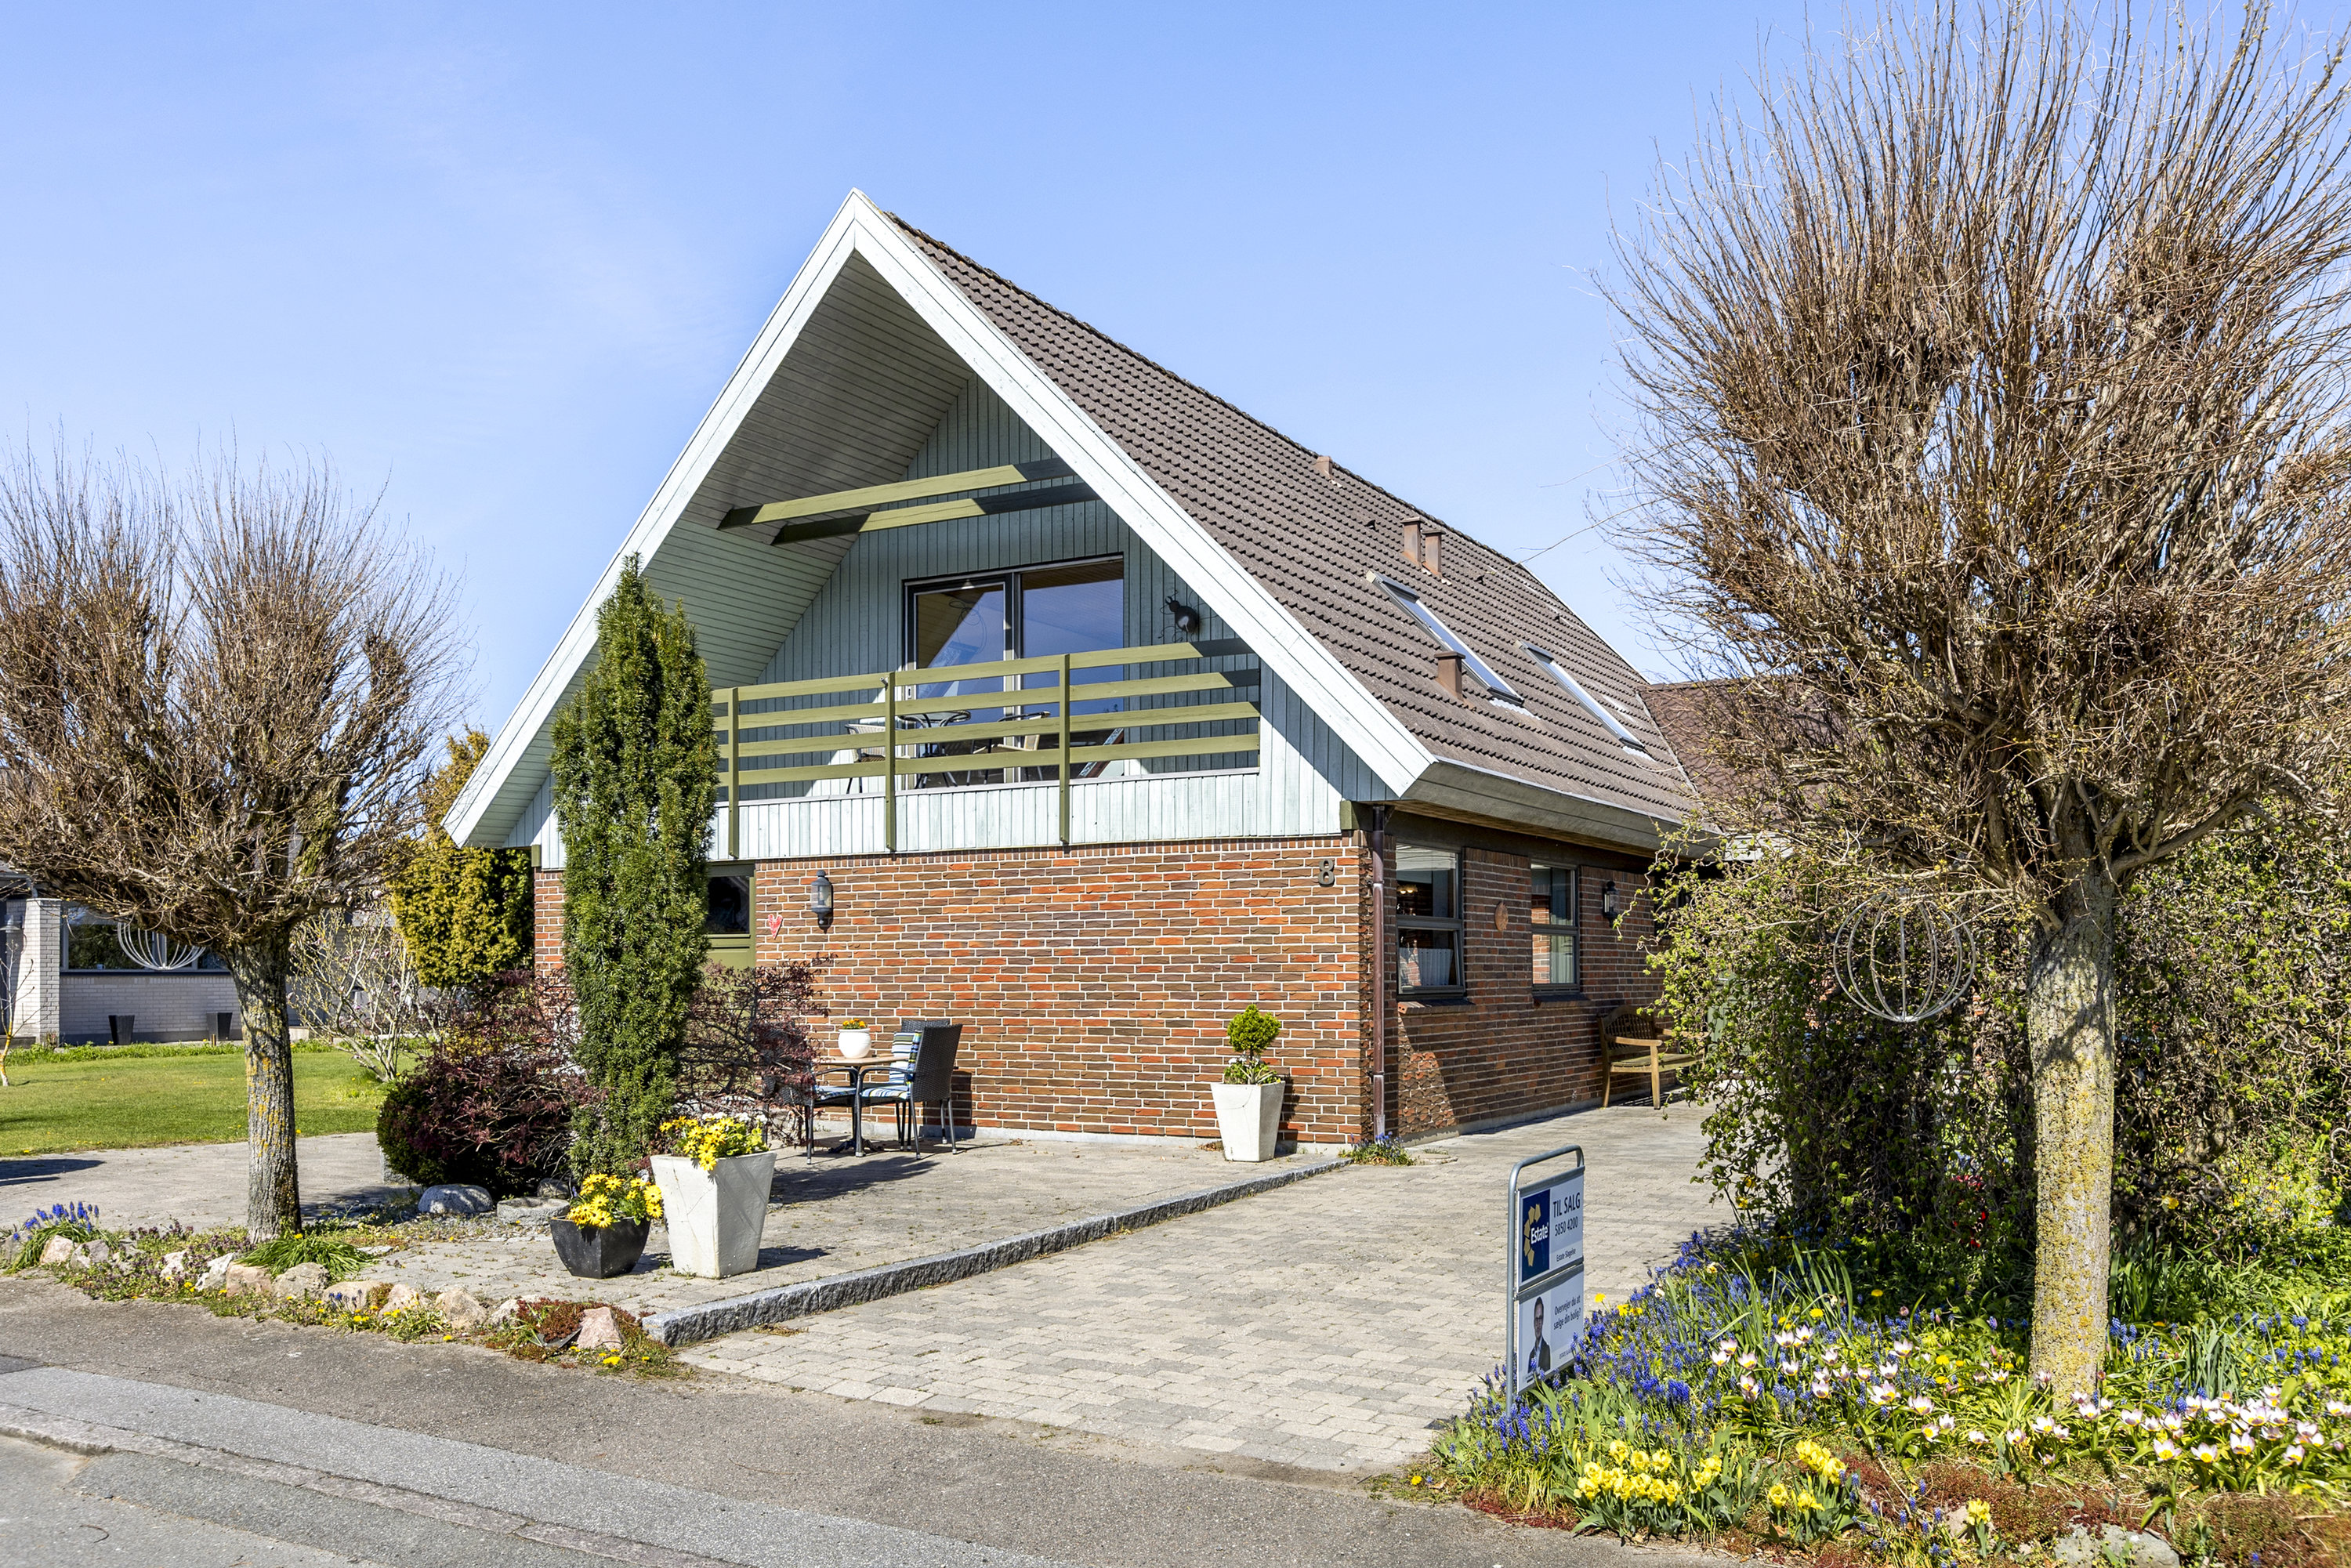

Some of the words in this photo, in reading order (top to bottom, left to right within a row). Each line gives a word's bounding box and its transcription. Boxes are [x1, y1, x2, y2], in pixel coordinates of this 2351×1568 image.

[1318, 858, 1335, 887] 8
[1552, 1199, 1562, 1218] TIL
[1564, 1192, 1580, 1214] SALG
[1531, 1224, 1549, 1244] Estate
[1555, 1222, 1566, 1237] 5850
[1567, 1216, 1578, 1230] 4200
[1571, 1297, 1577, 1306] du
[1553, 1318, 1564, 1330] sælge
[1570, 1307, 1581, 1320] bolig?
